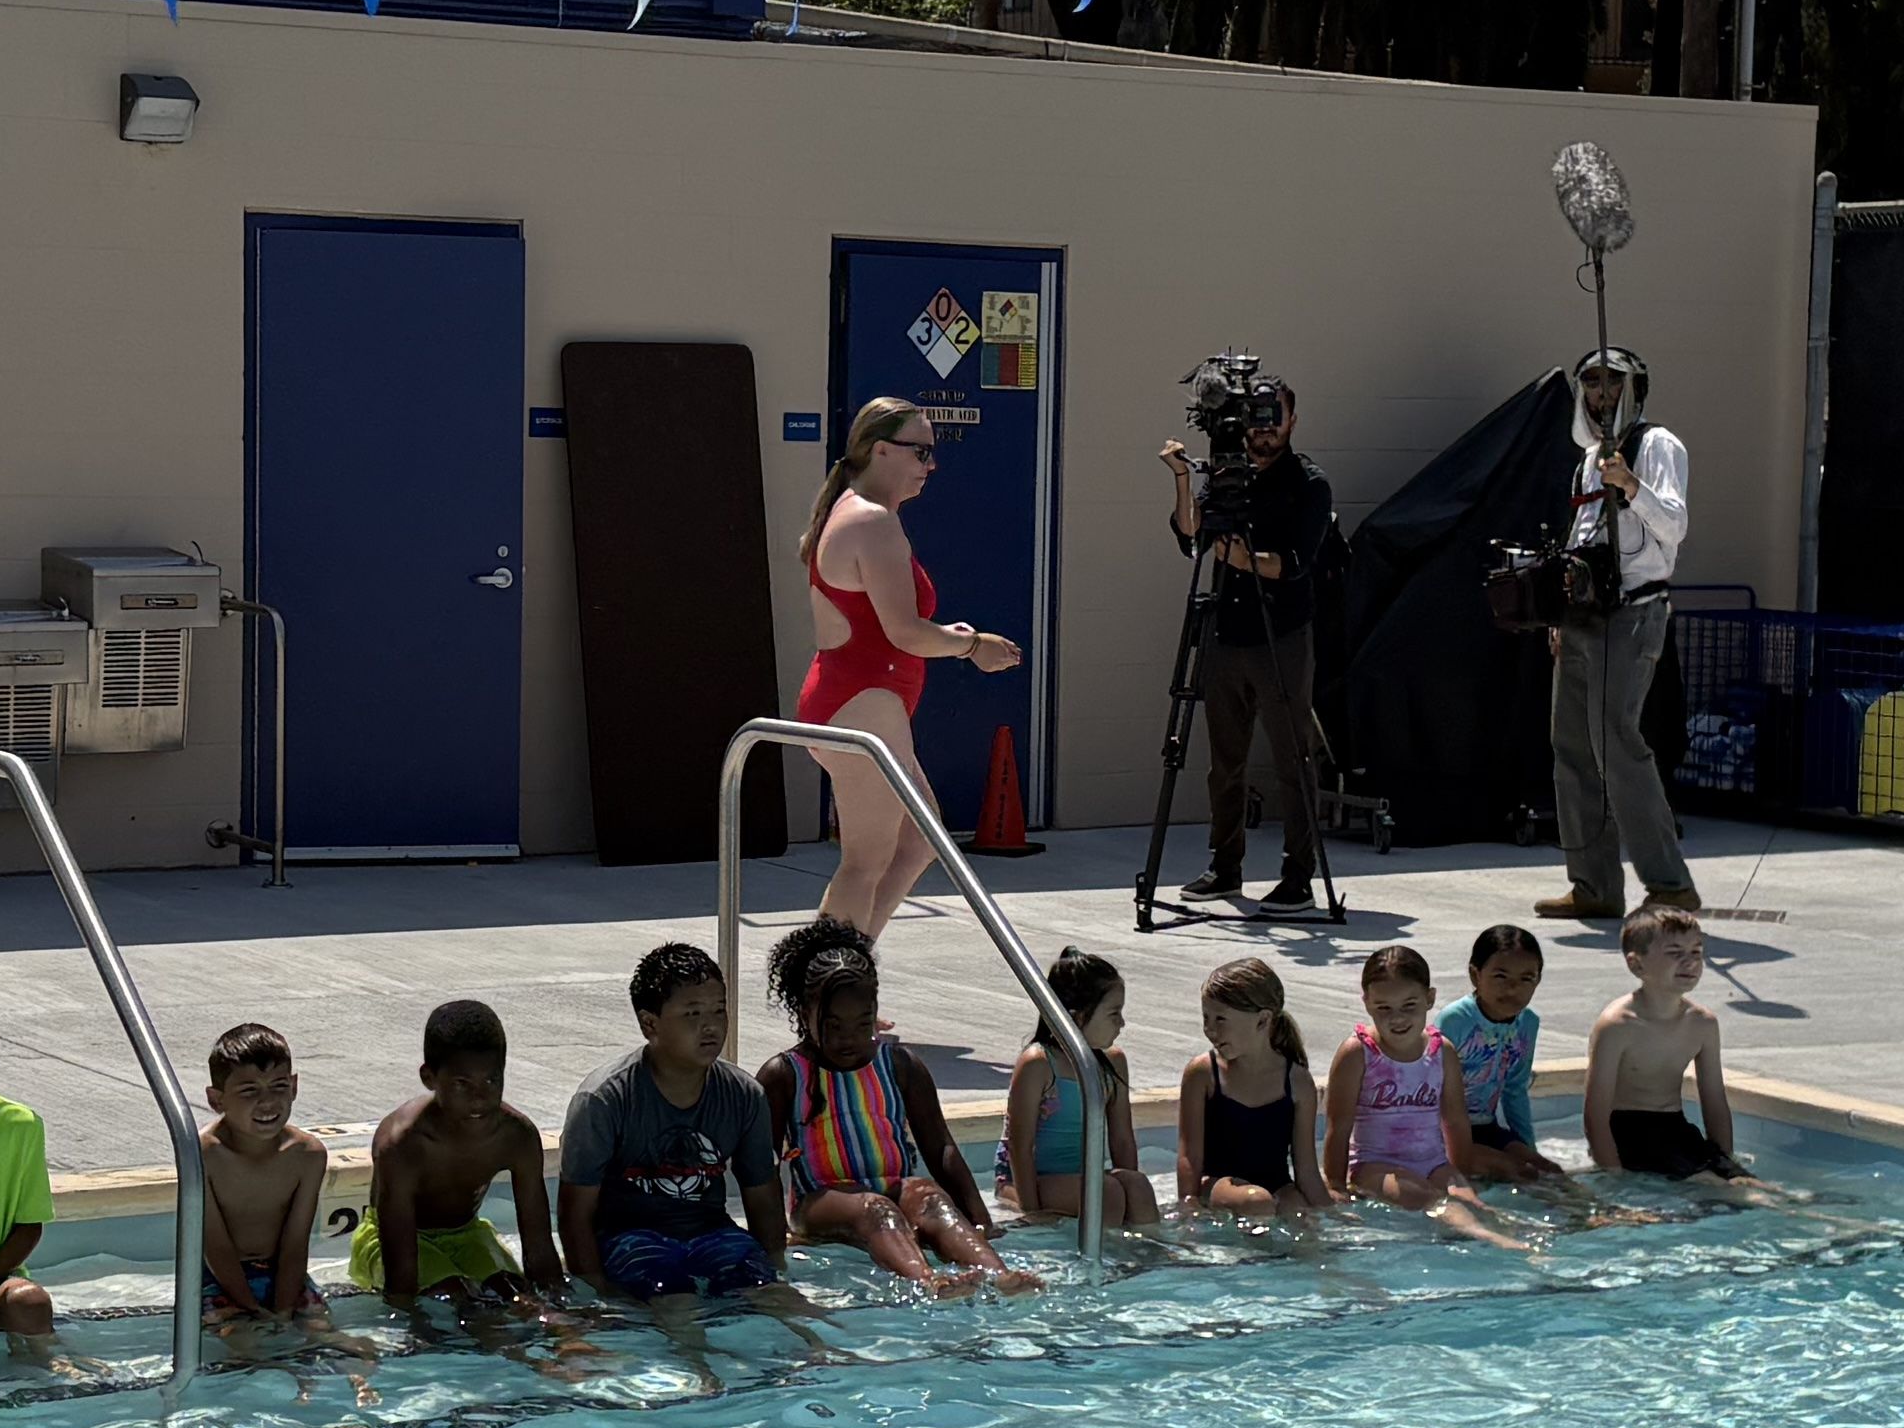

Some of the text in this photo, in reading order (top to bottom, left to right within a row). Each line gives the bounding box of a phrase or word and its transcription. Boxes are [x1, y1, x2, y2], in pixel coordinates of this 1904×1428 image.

[936, 293, 951, 321] 0
[917, 317, 933, 345] 3
[954, 316, 970, 344] 2
